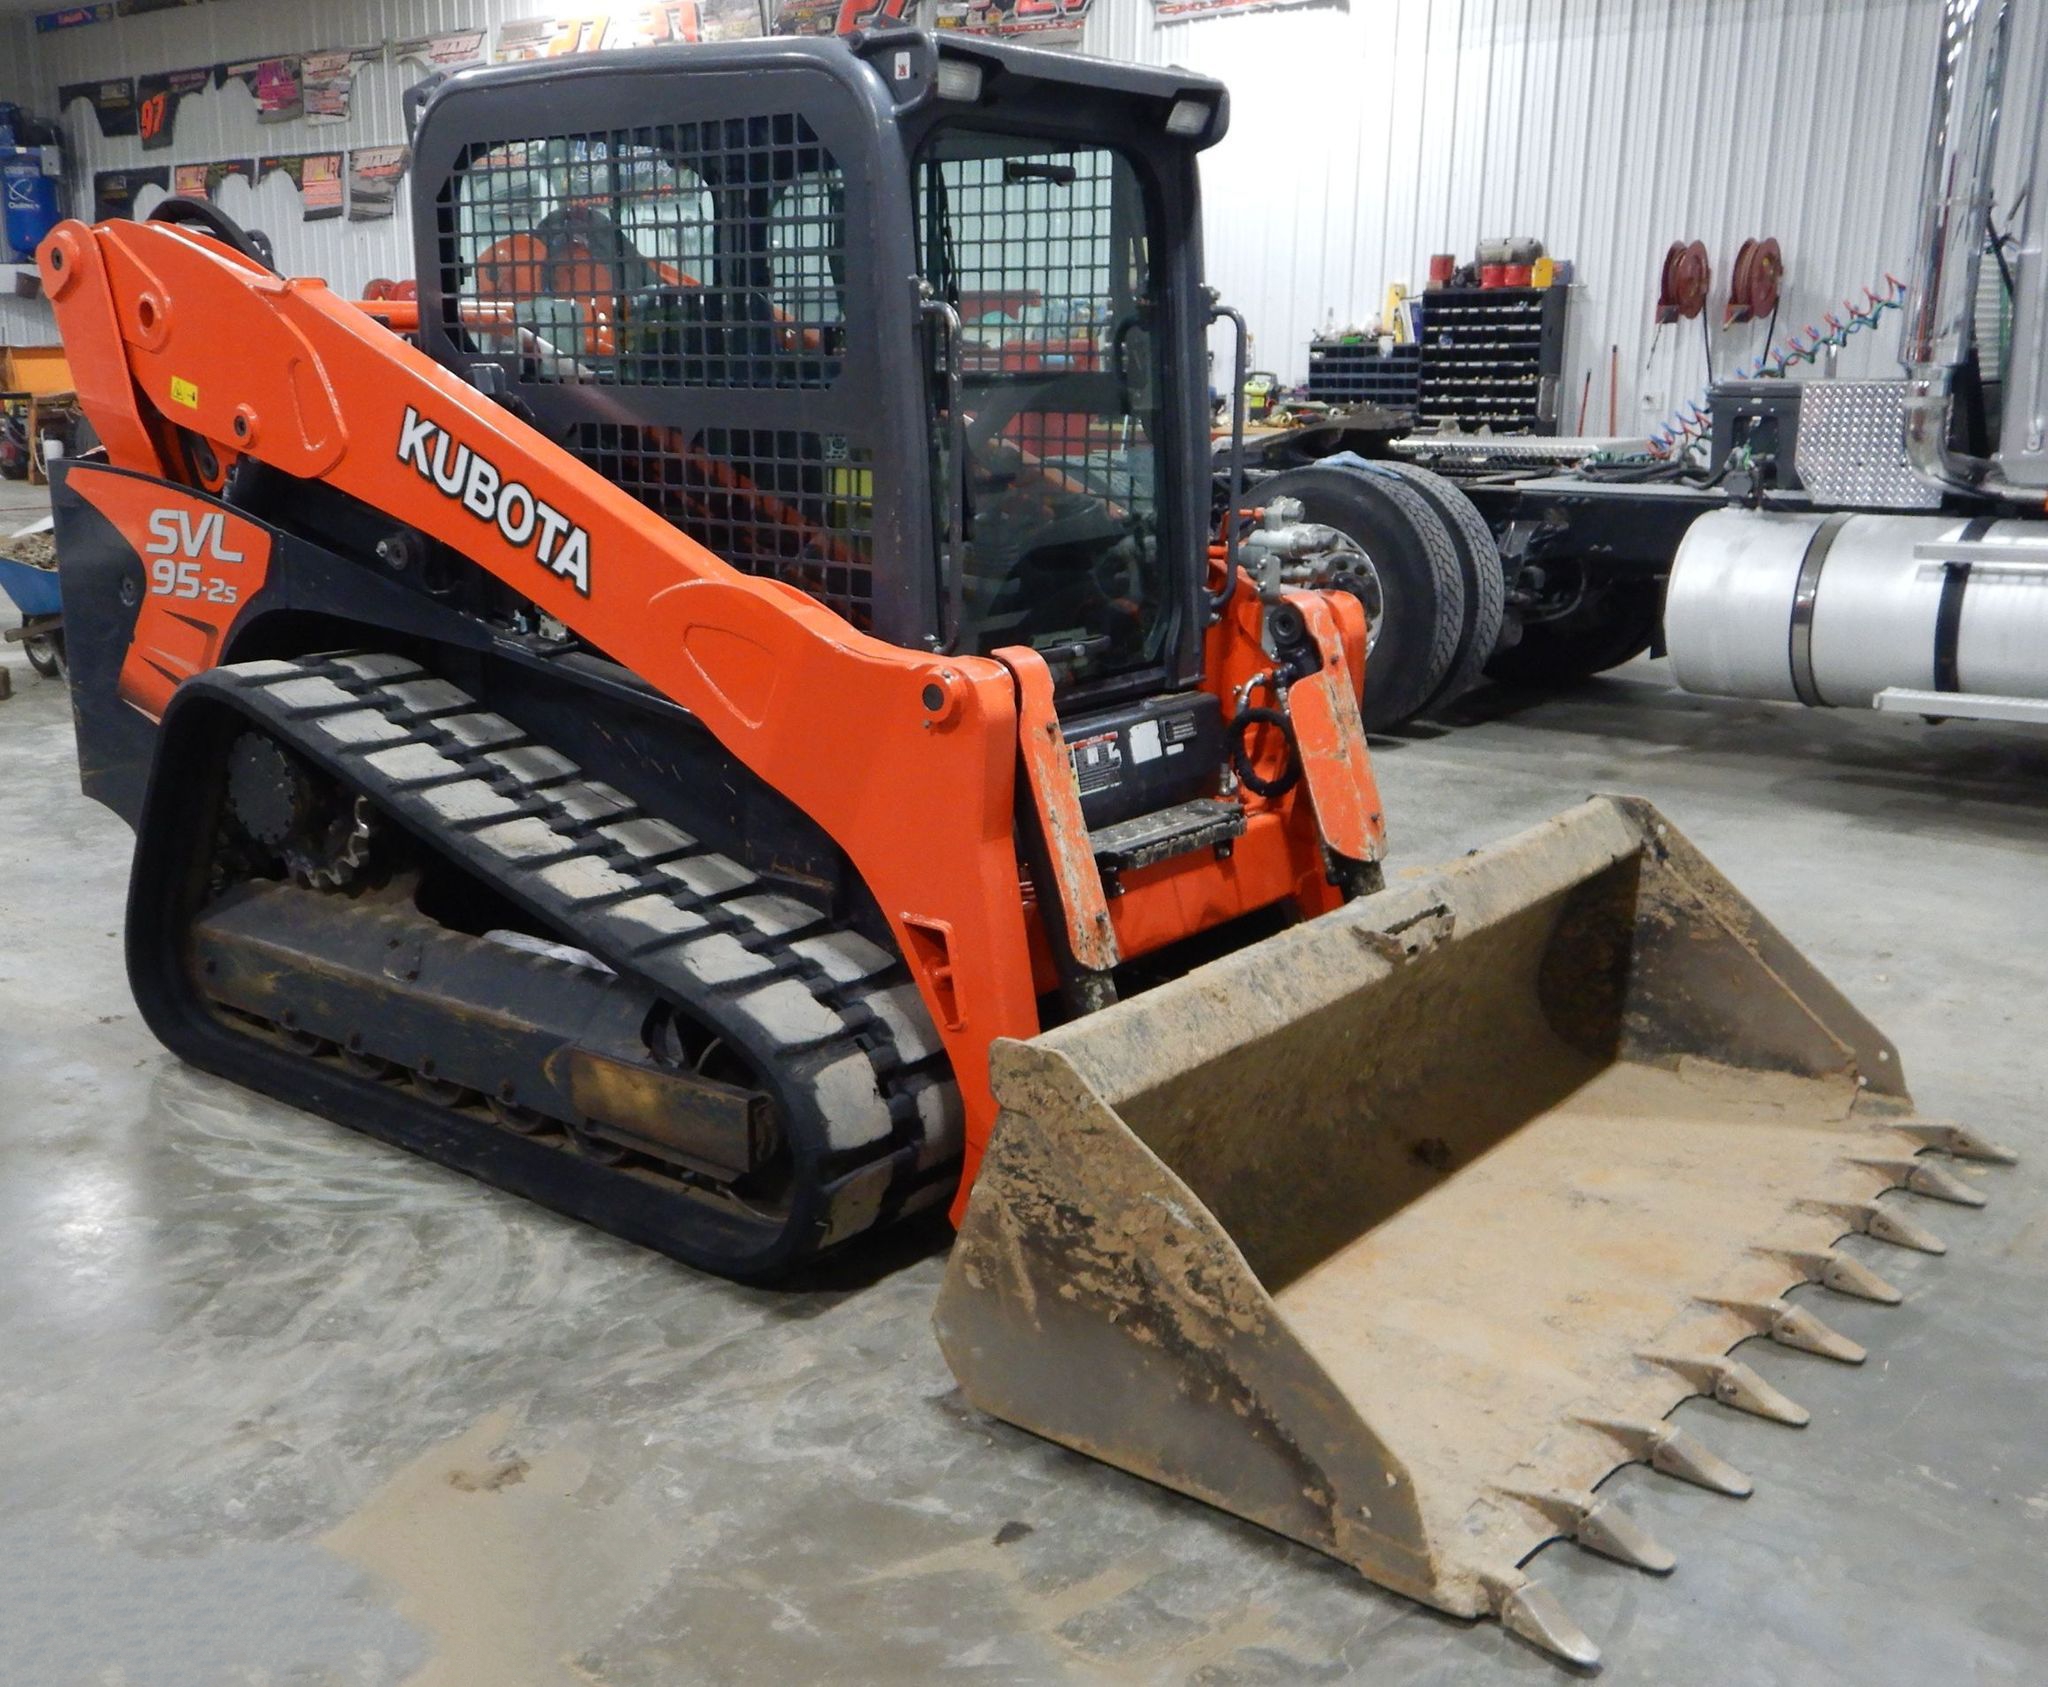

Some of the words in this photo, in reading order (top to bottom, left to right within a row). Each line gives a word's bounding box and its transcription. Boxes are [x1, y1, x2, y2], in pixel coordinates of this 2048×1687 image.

[141, 93, 166, 139] 97
[397, 404, 591, 599] KUBOTA
[145, 508, 244, 563] SVL
